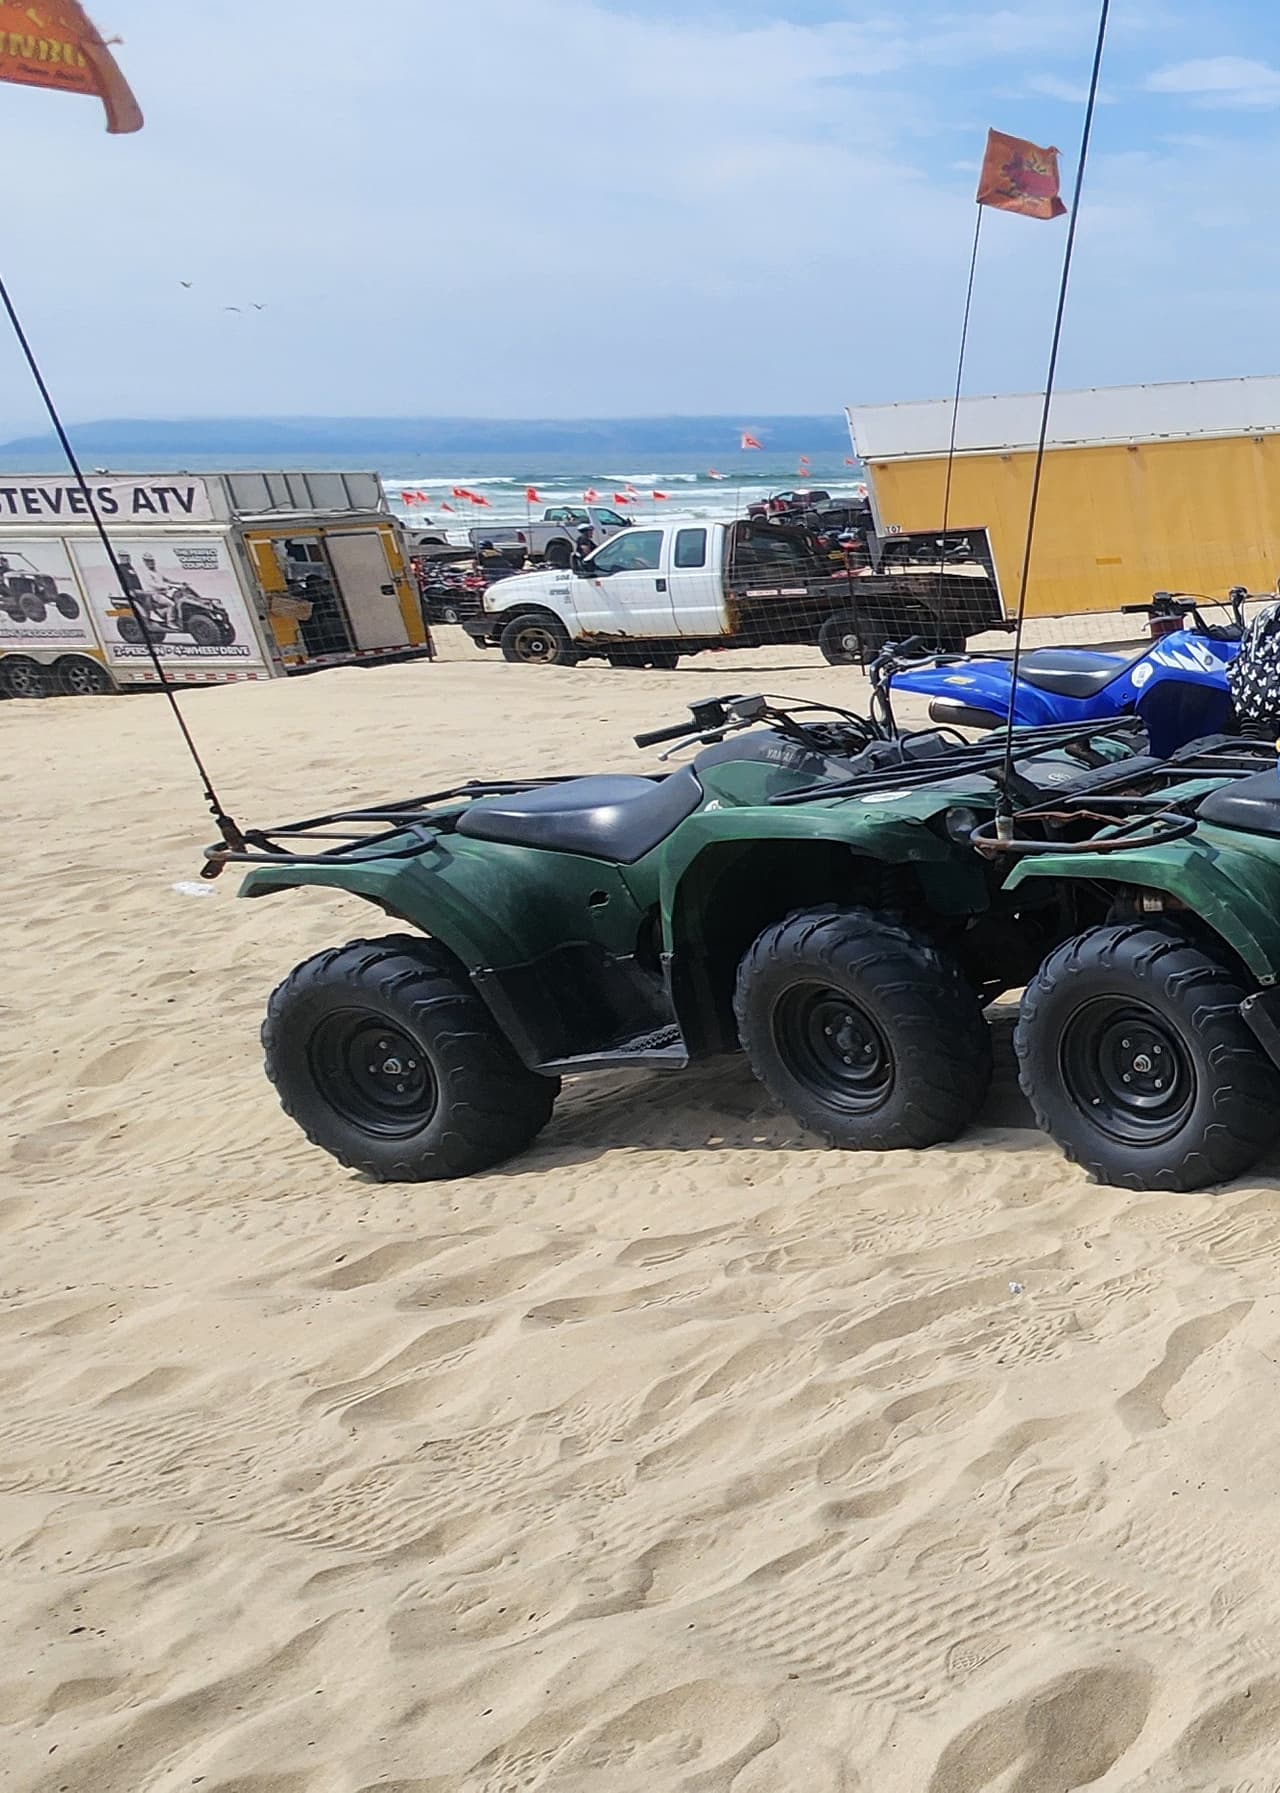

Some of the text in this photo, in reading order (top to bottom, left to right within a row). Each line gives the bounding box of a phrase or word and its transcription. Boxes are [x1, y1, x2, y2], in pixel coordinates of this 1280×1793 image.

[0, 486, 195, 514] TEVE'S ATV
[113, 645, 165, 657] 2-PERSN
